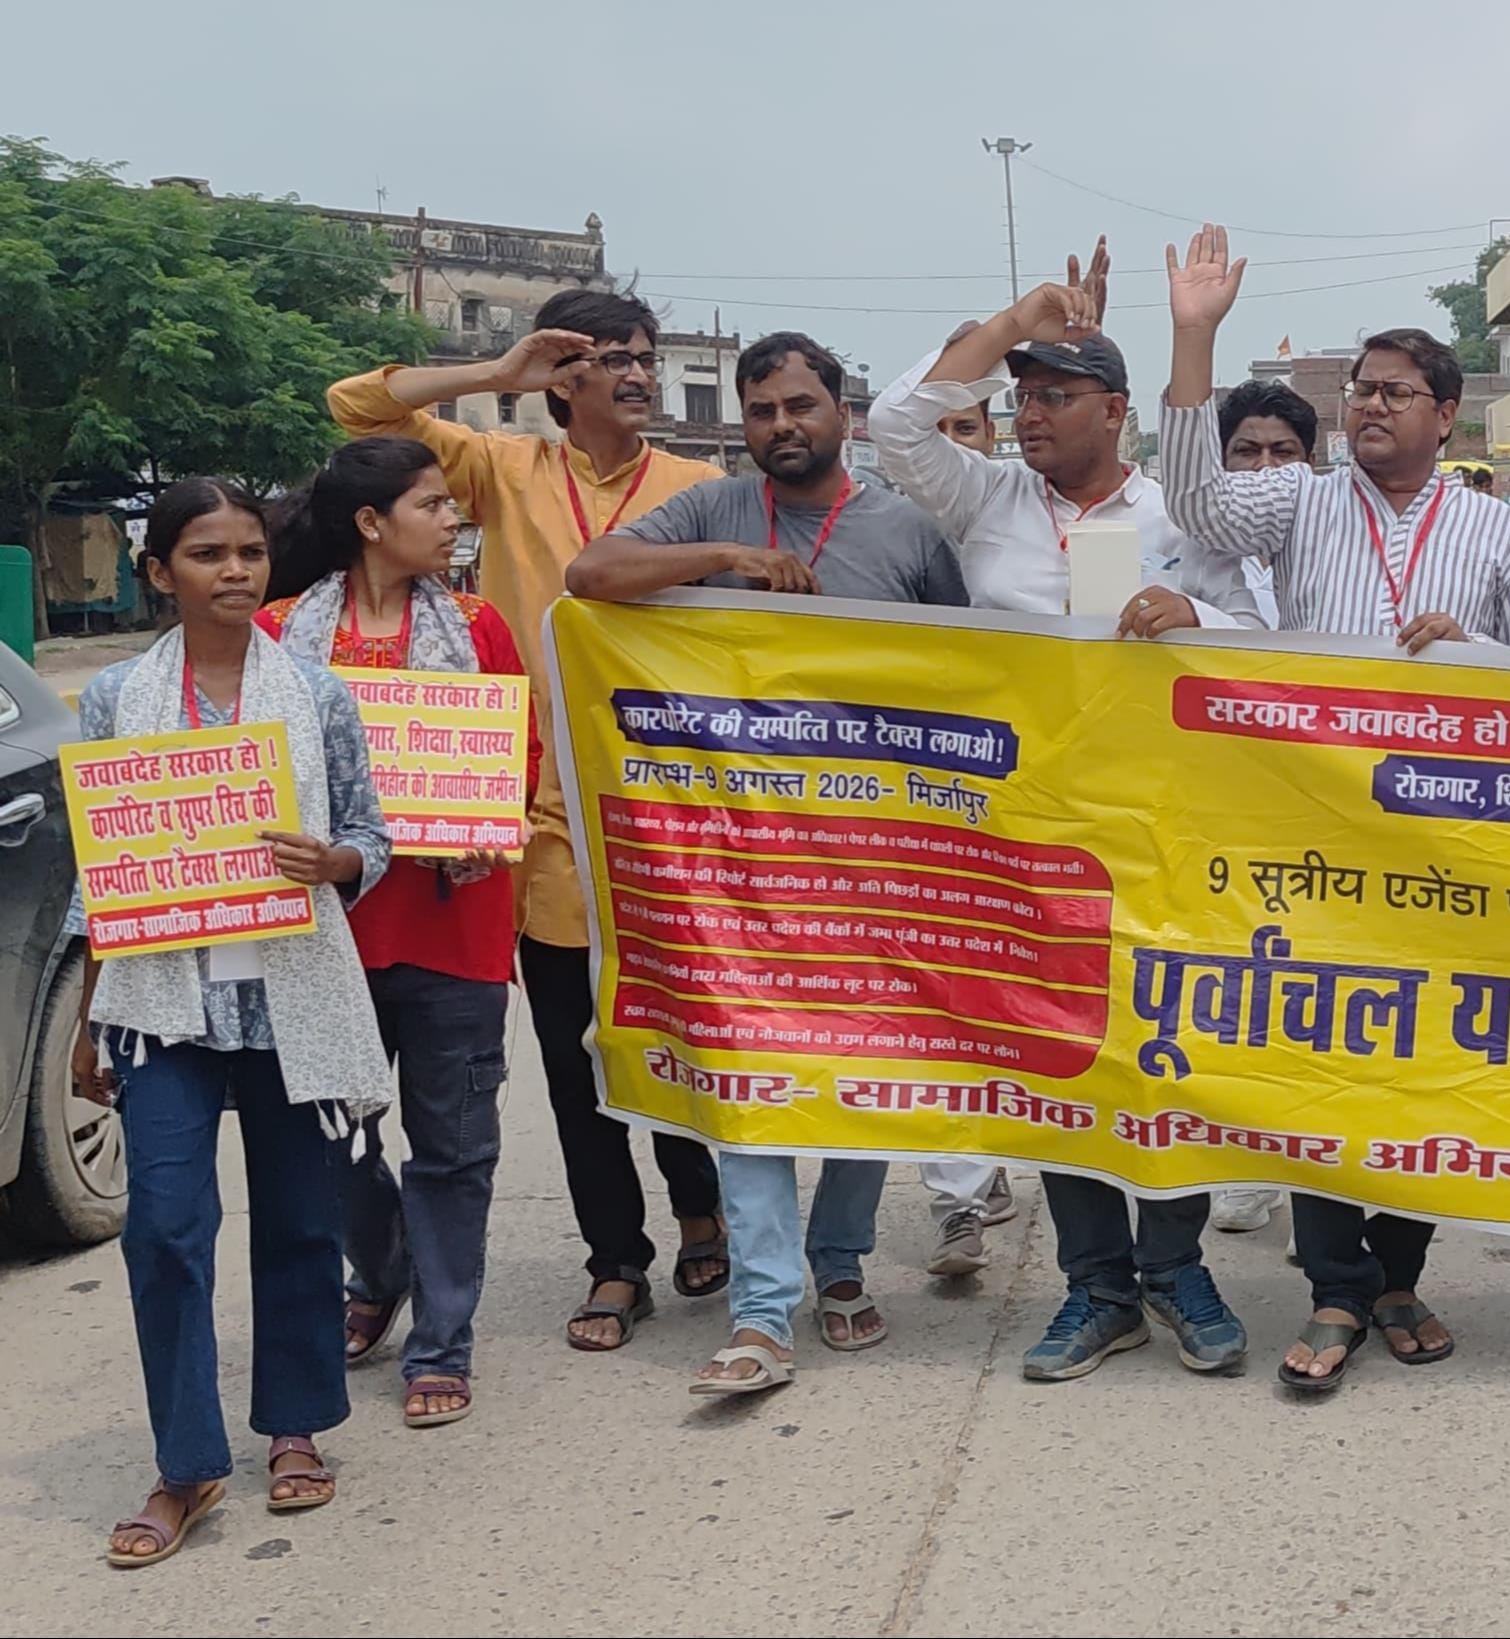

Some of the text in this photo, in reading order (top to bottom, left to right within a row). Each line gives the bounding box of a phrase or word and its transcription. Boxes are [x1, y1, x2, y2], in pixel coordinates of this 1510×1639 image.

[422, 685, 480, 708] सरकार
[1205, 695, 1320, 730] सरकार
[1329, 705, 1464, 742] जवाबदेह
[622, 701, 704, 734] कारपोरेट
[710, 708, 743, 737] की
[749, 711, 829, 742] सम्पत्ति
[836, 719, 867, 744] पर
[875, 715, 923, 749] टैक्स
[74, 750, 161, 788] जवाबदेह
[166, 746, 235, 778] सरकार
[431, 768, 481, 800] आवासीय
[1395, 766, 1486, 808] रोजगार,
[157, 799, 174, 831] व
[175, 795, 215, 841] सुपर
[216, 783, 249, 825] रिच
[250, 779, 277, 820] की
[725, 769, 805, 796] अगस्त
[908, 772, 988, 824] मिर्जापुर
[151, 858, 176, 890] पर
[173, 847, 219, 886] टैक्स
[1208, 856, 1230, 895] 9
[1247, 849, 1367, 915] सूत्रीय
[1382, 864, 1490, 918] एजेंडा
[204, 902, 254, 930] अधिकार
[256, 896, 308, 925] अभियान
[776, 972, 793, 987] की
[868, 979, 884, 991] पर
[1131, 924, 1429, 1082] पूर्वांचल
[837, 1078, 1095, 1130] सामाजिक
[1114, 1111, 1344, 1165] अधिकार
